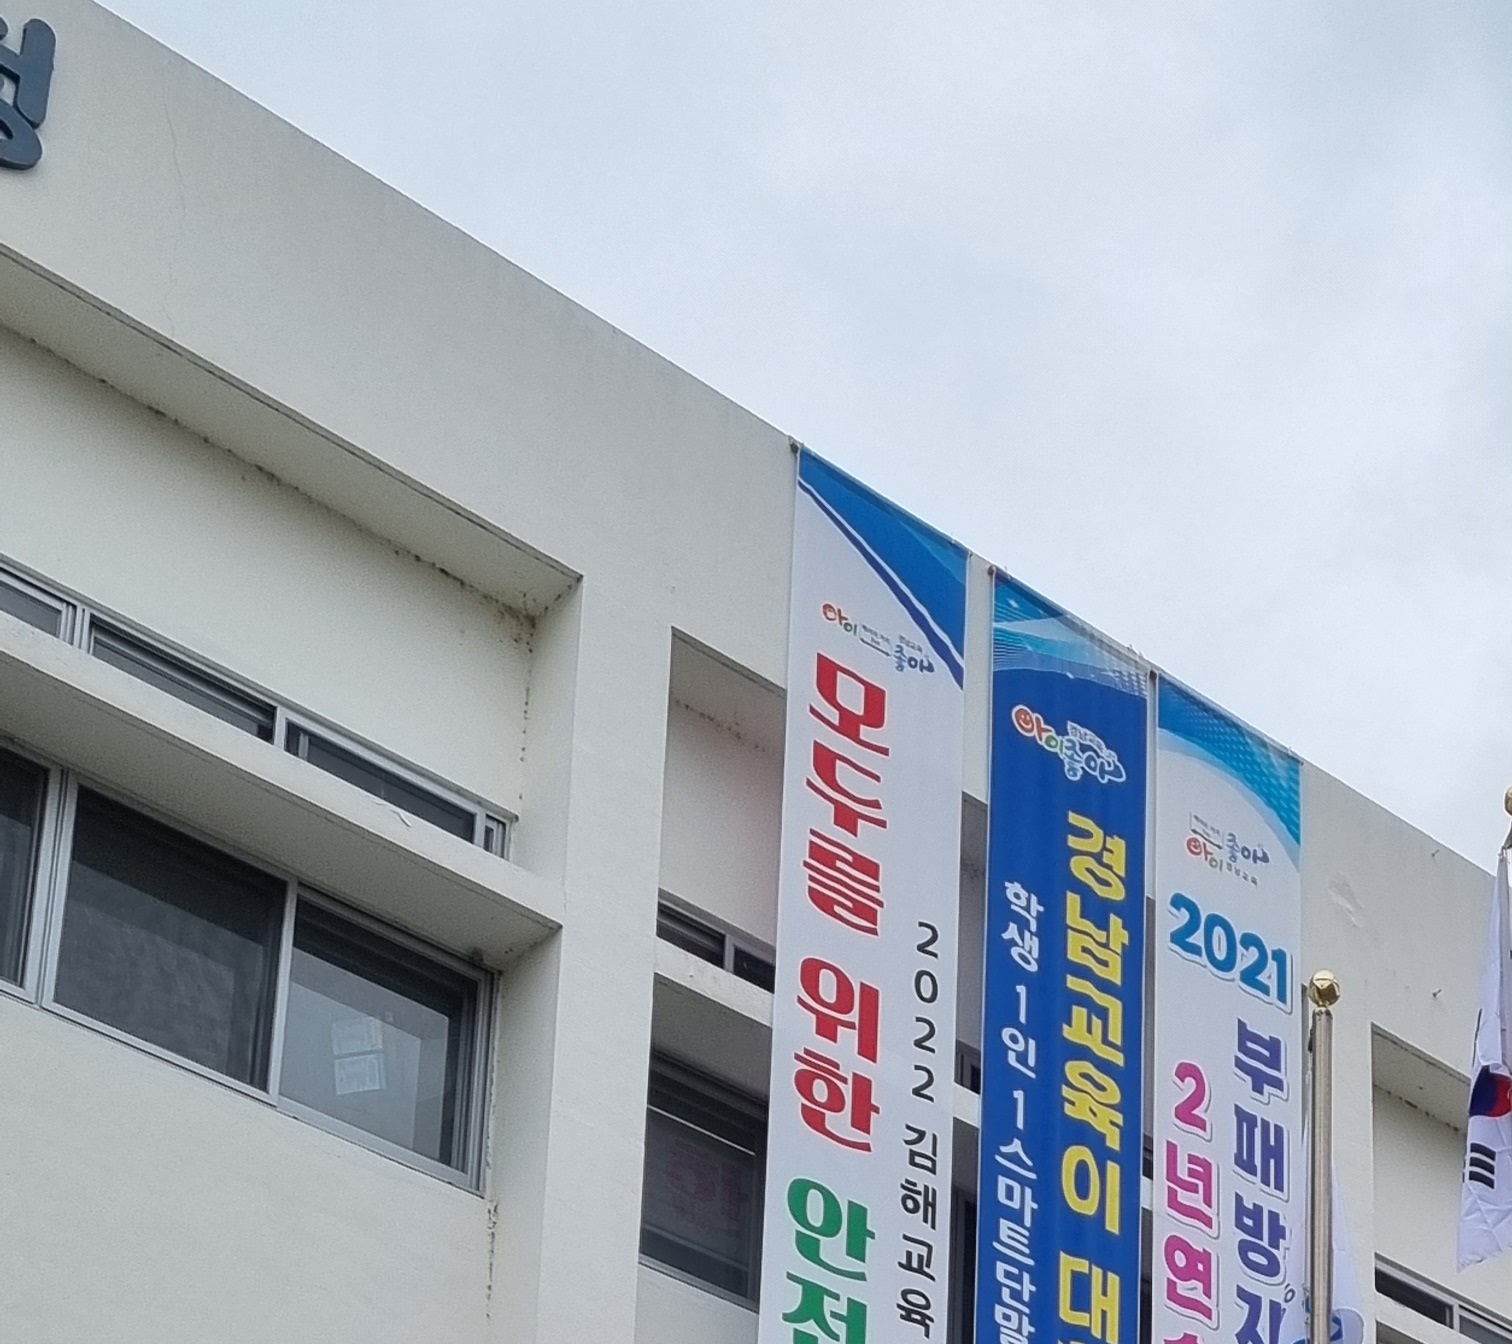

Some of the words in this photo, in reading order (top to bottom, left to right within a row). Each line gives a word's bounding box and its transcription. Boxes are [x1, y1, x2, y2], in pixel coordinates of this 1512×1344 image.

[805, 651, 891, 938] 모두를
[911, 919, 941, 1104] 2022
[1001, 880, 1043, 974] 학생
[1168, 892, 1292, 1010] 2021
[792, 956, 881, 1154] 위한
[1001, 985, 1037, 1079] 1인
[1061, 810, 1129, 1236] 경남교육이
[897, 1124, 939, 1339] 김해교육
